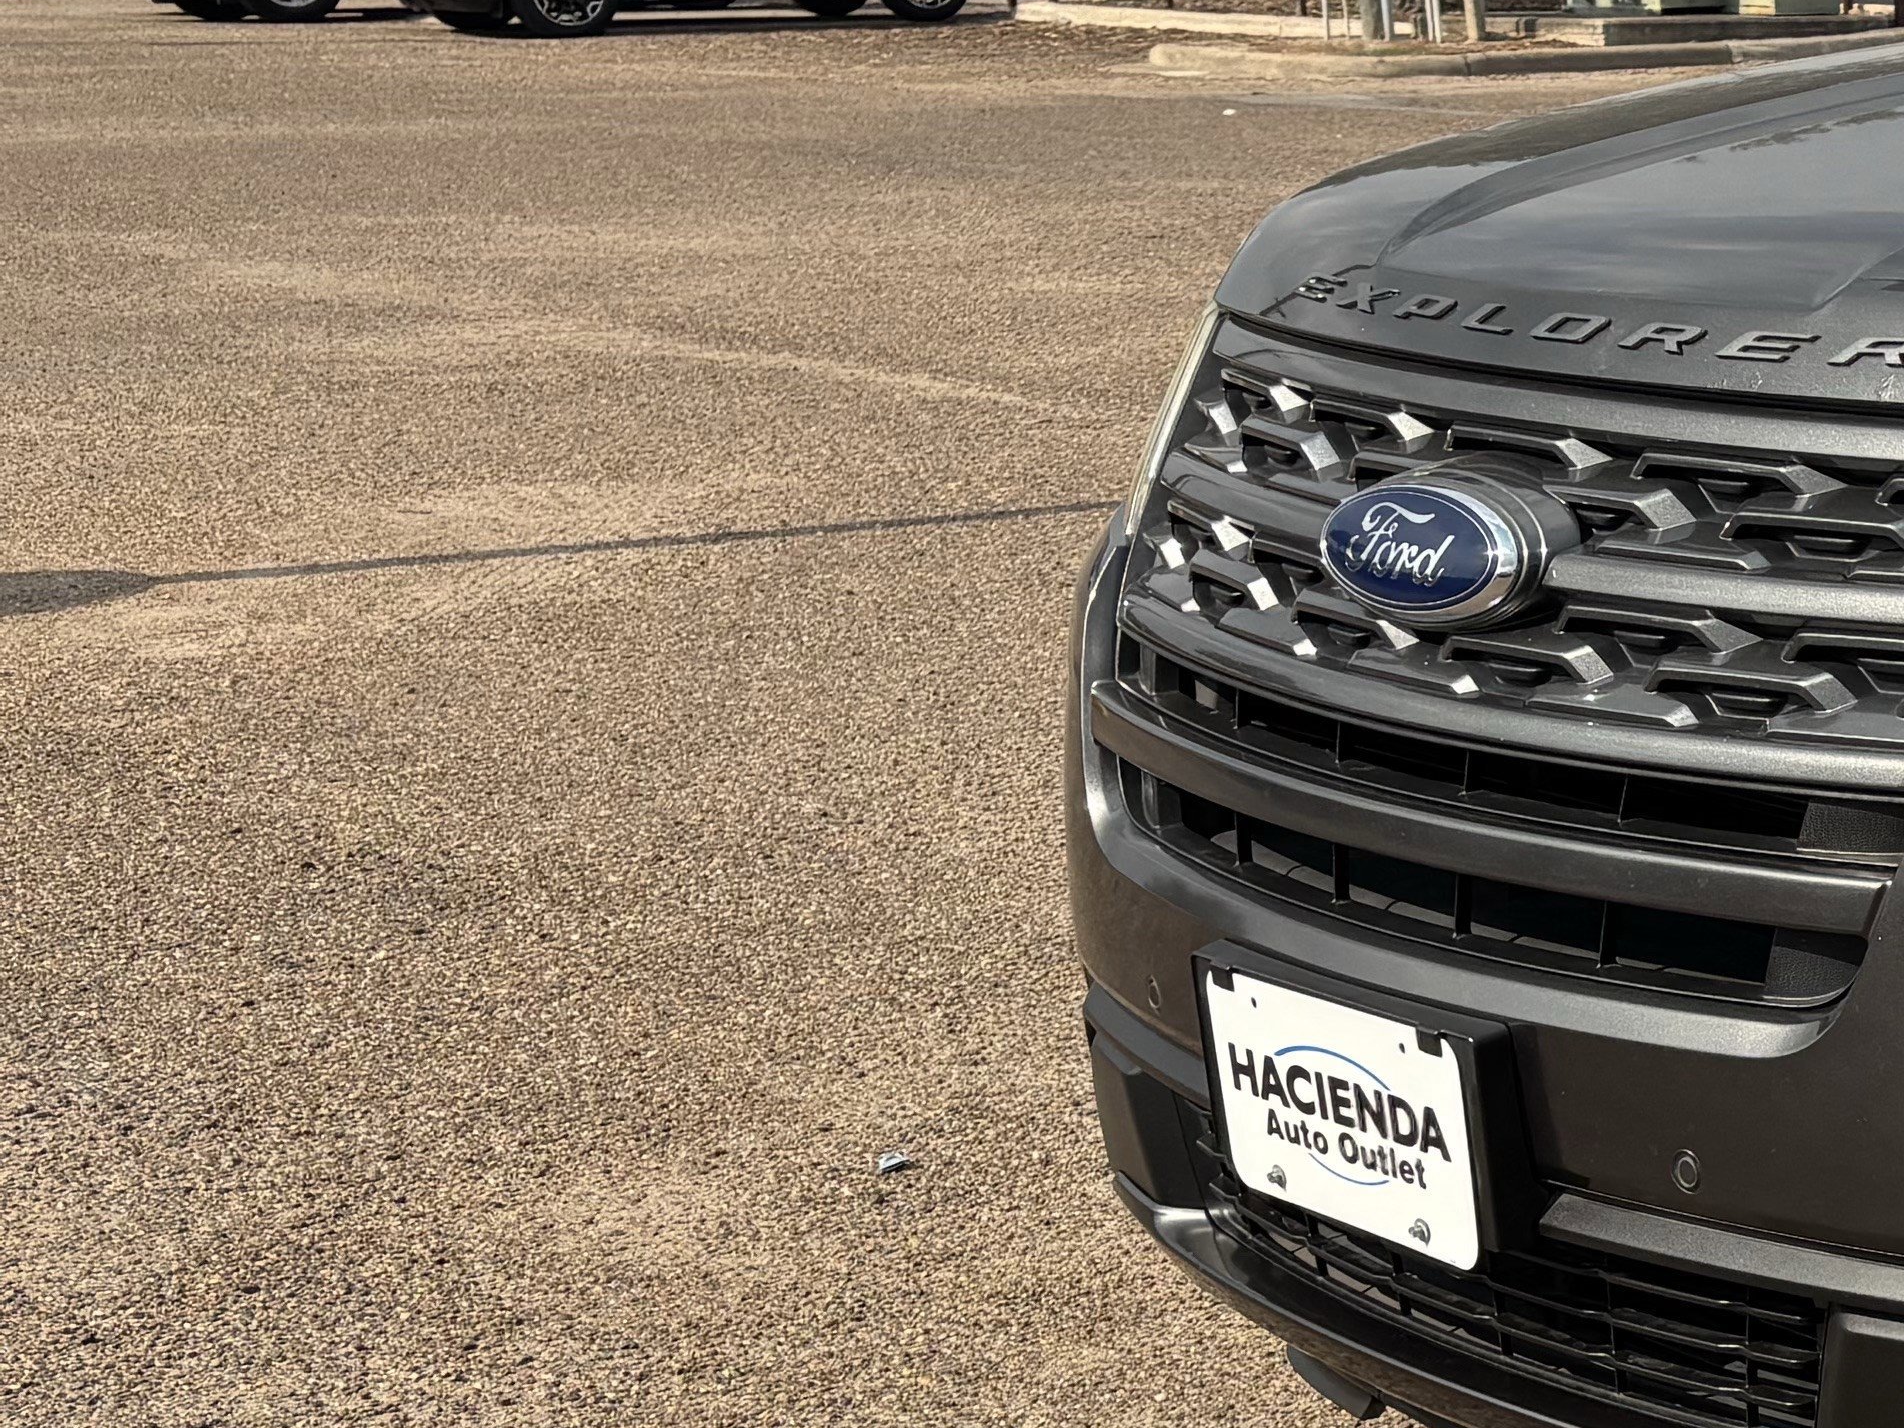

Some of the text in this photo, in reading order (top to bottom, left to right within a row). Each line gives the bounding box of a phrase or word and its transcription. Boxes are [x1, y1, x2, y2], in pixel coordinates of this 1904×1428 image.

[1345, 501, 1456, 588] Ford
[1227, 1041, 1452, 1163] HACIENDA
[1267, 1108, 1427, 1190] Auto Outlet
